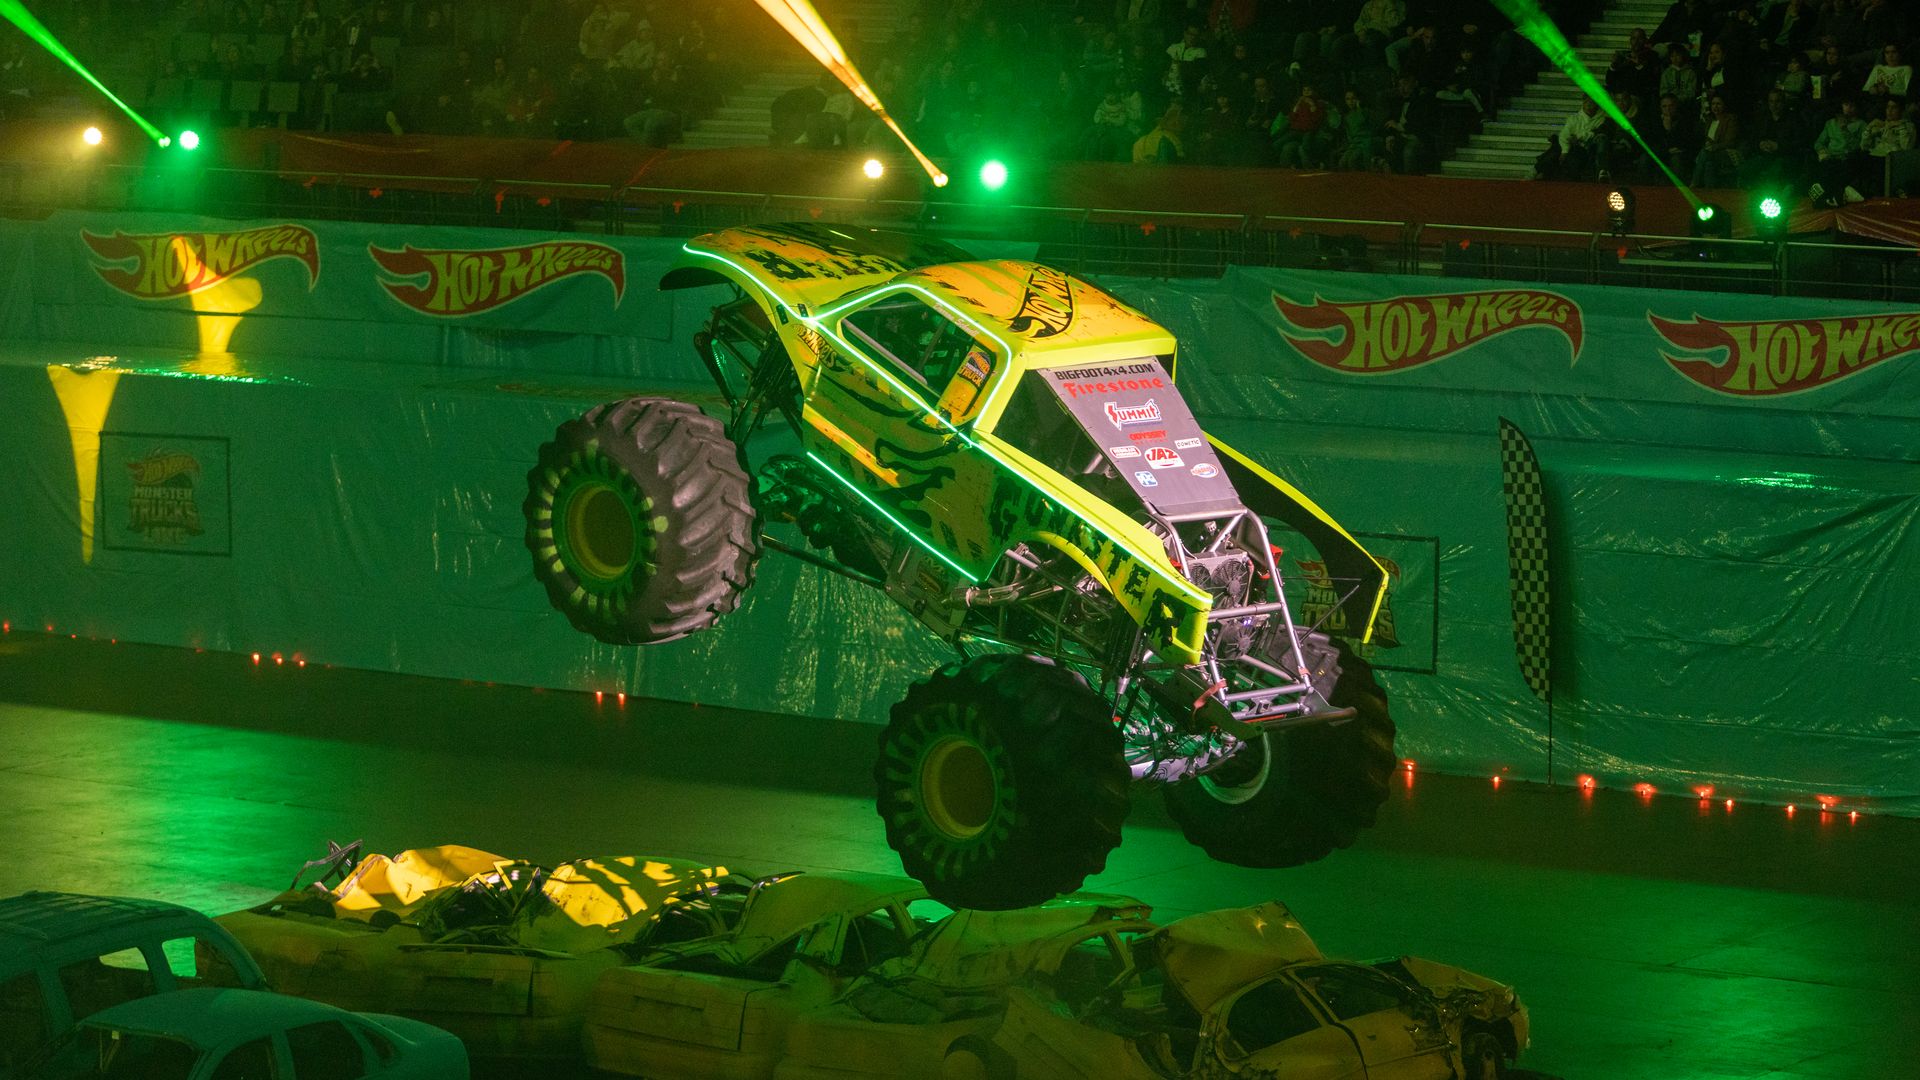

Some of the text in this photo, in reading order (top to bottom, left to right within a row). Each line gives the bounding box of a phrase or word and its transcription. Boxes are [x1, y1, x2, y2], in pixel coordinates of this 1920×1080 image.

[1337, 302, 1430, 368] HOT
[1719, 323, 1821, 391] HOT
[1063, 377, 1164, 399] Firestone
[1146, 448, 1179, 461] JAZ
[1302, 603, 1396, 637] TRUS
